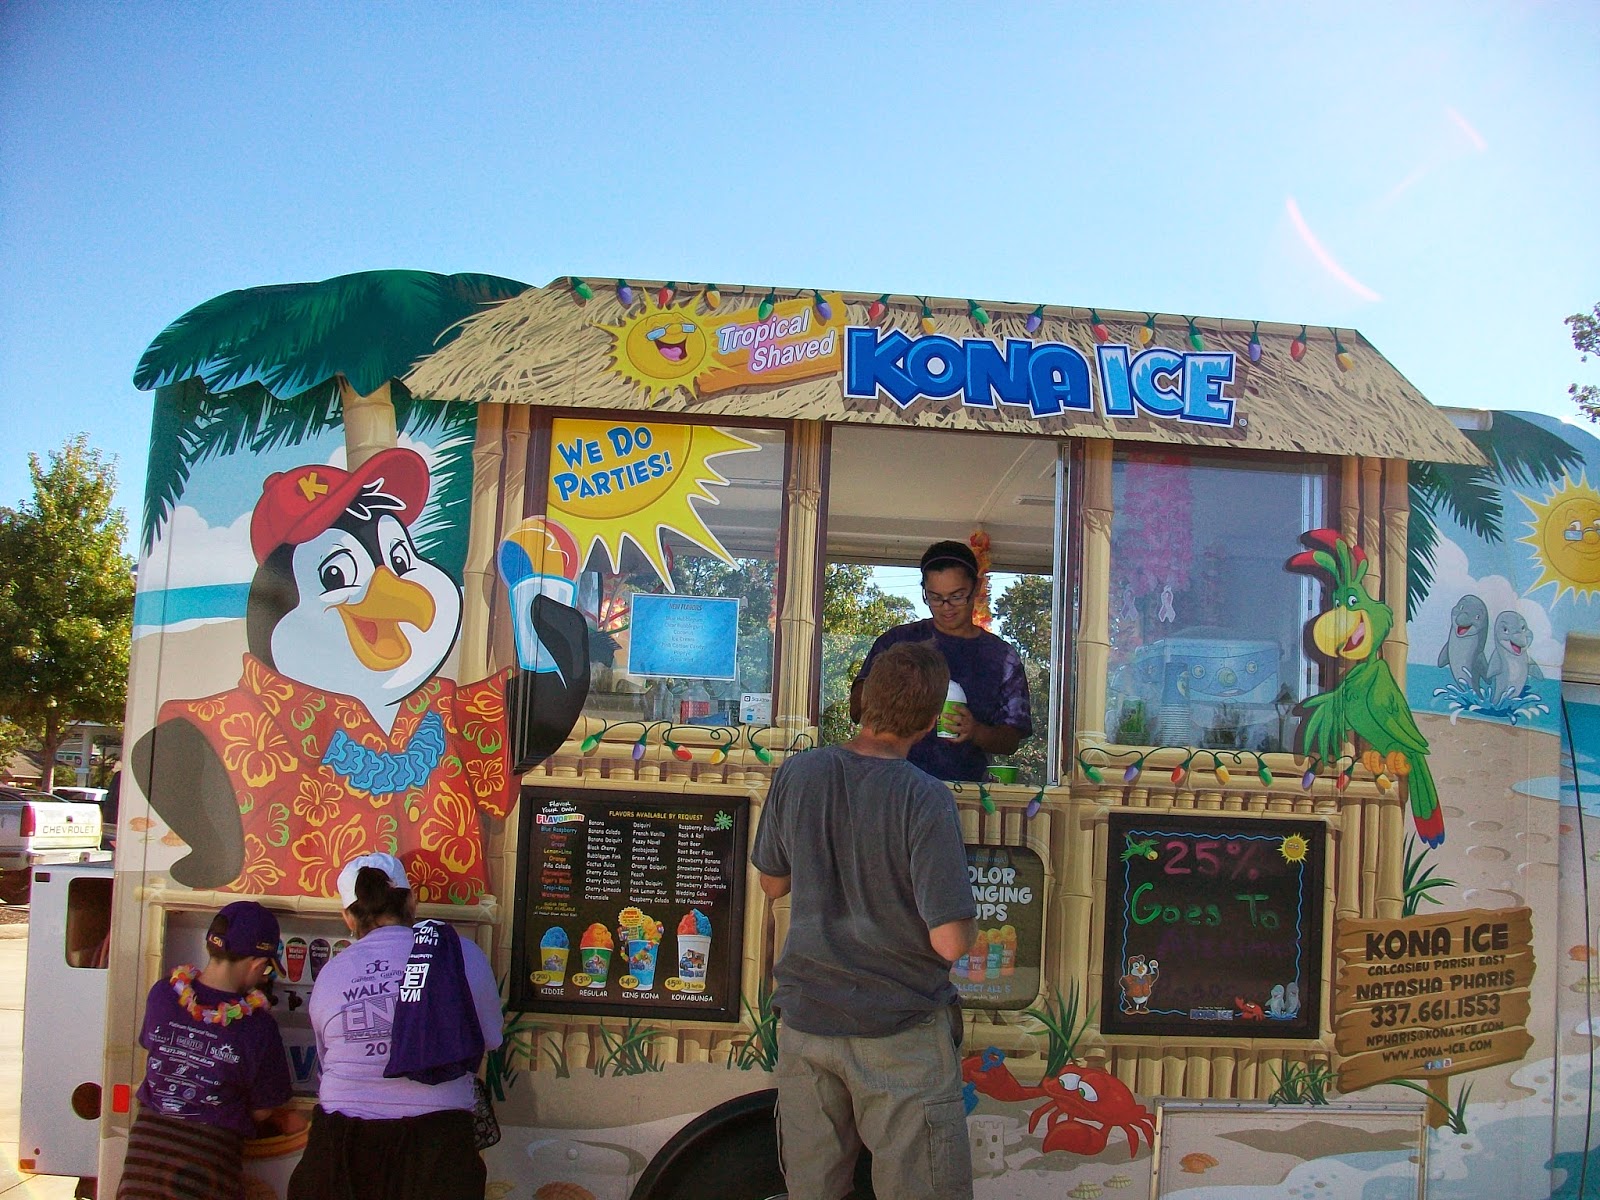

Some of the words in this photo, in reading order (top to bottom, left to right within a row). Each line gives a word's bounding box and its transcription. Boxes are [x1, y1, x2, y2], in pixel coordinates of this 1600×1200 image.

[720, 308, 810, 351] Tropical
[752, 330, 835, 373] Shaved
[844, 325, 1092, 418] KONA
[1095, 343, 1237, 428] ICE
[557, 437, 603, 471] WE
[607, 425, 654, 458] DO
[553, 451, 674, 502] PARTIES!
[42, 825, 95, 834] CHEVROLET
[1163, 841, 1260, 881] 25%
[967, 866, 1016, 886] OLOR
[971, 885, 1032, 904] NGING
[975, 903, 1008, 922] UPS
[1131, 882, 1222, 927] Goes
[1234, 894, 1280, 930] To
[209, 934, 223, 947] LSU
[1365, 927, 1451, 961] KONA
[1463, 923, 1509, 953] ICE
[406, 965, 426, 973] ALZ
[1368, 962, 1430, 976] CALCASIEU
[1434, 957, 1475, 971] PARISH
[1479, 954, 1506, 965] EAST
[343, 981, 391, 1002] WALK
[400, 988, 421, 1002] WA
[541, 988, 565, 996] KIDDIE
[579, 989, 608, 997] REGULAR
[622, 991, 639, 999] KING
[640, 992, 659, 1000] KONA
[952, 983, 984, 993] OLLECT
[1356, 976, 1443, 1001] NATASHA
[1450, 969, 1516, 991] PHARIS
[671, 994, 713, 1002] KOWABUNGA
[344, 996, 398, 1032] EN
[1370, 993, 1501, 1028] 337.661.1553
[1366, 1021, 1505, 1047] NPHARIS@KONA-ICE.COM
[210, 1046, 240, 1063] SUNRISE
[365, 1042, 388, 1057] 20
[1382, 1039, 1492, 1063] WWW.KONA-ICE.COM
